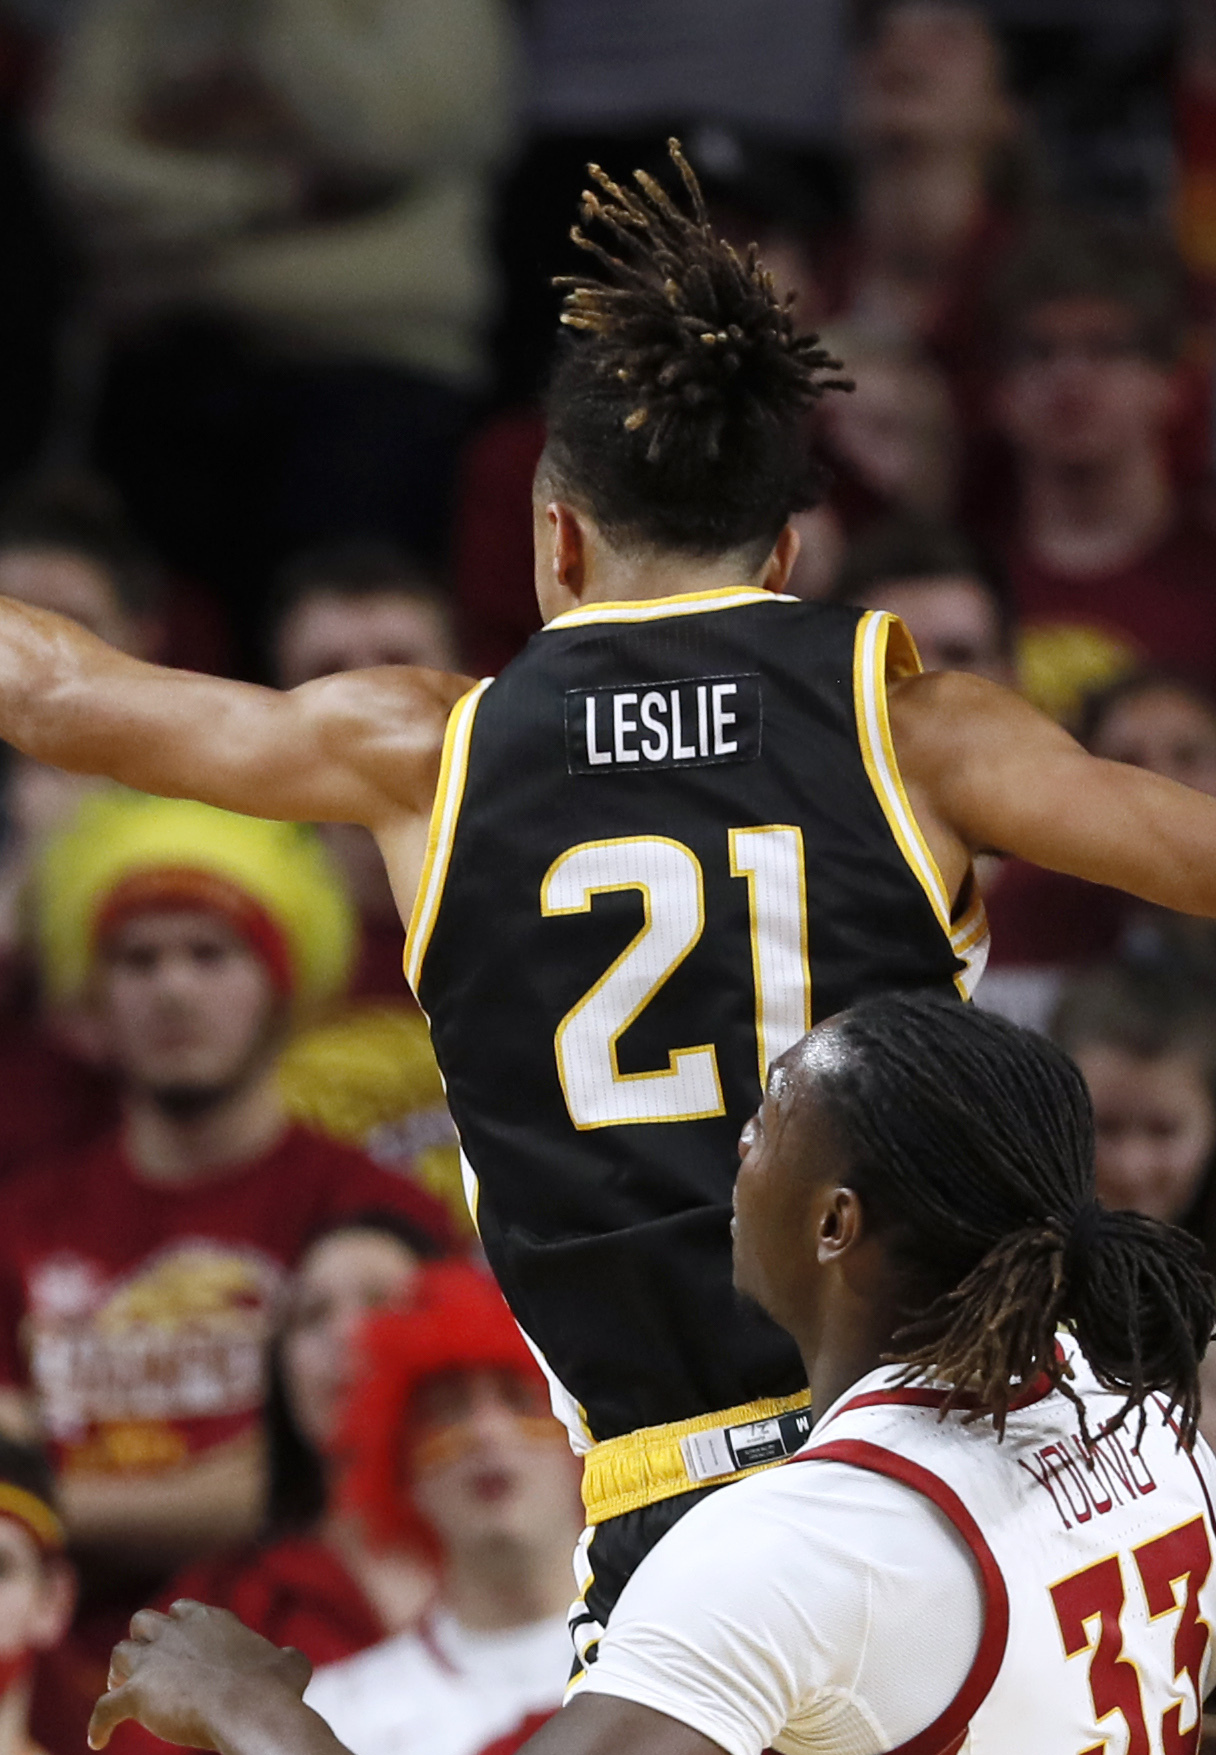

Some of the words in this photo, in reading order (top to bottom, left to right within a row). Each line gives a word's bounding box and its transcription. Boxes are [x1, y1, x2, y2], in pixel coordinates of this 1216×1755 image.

[585, 683, 738, 765] LESLIE
[540, 824, 812, 1131] 21
[1017, 1418, 1157, 1529] YOUNG
